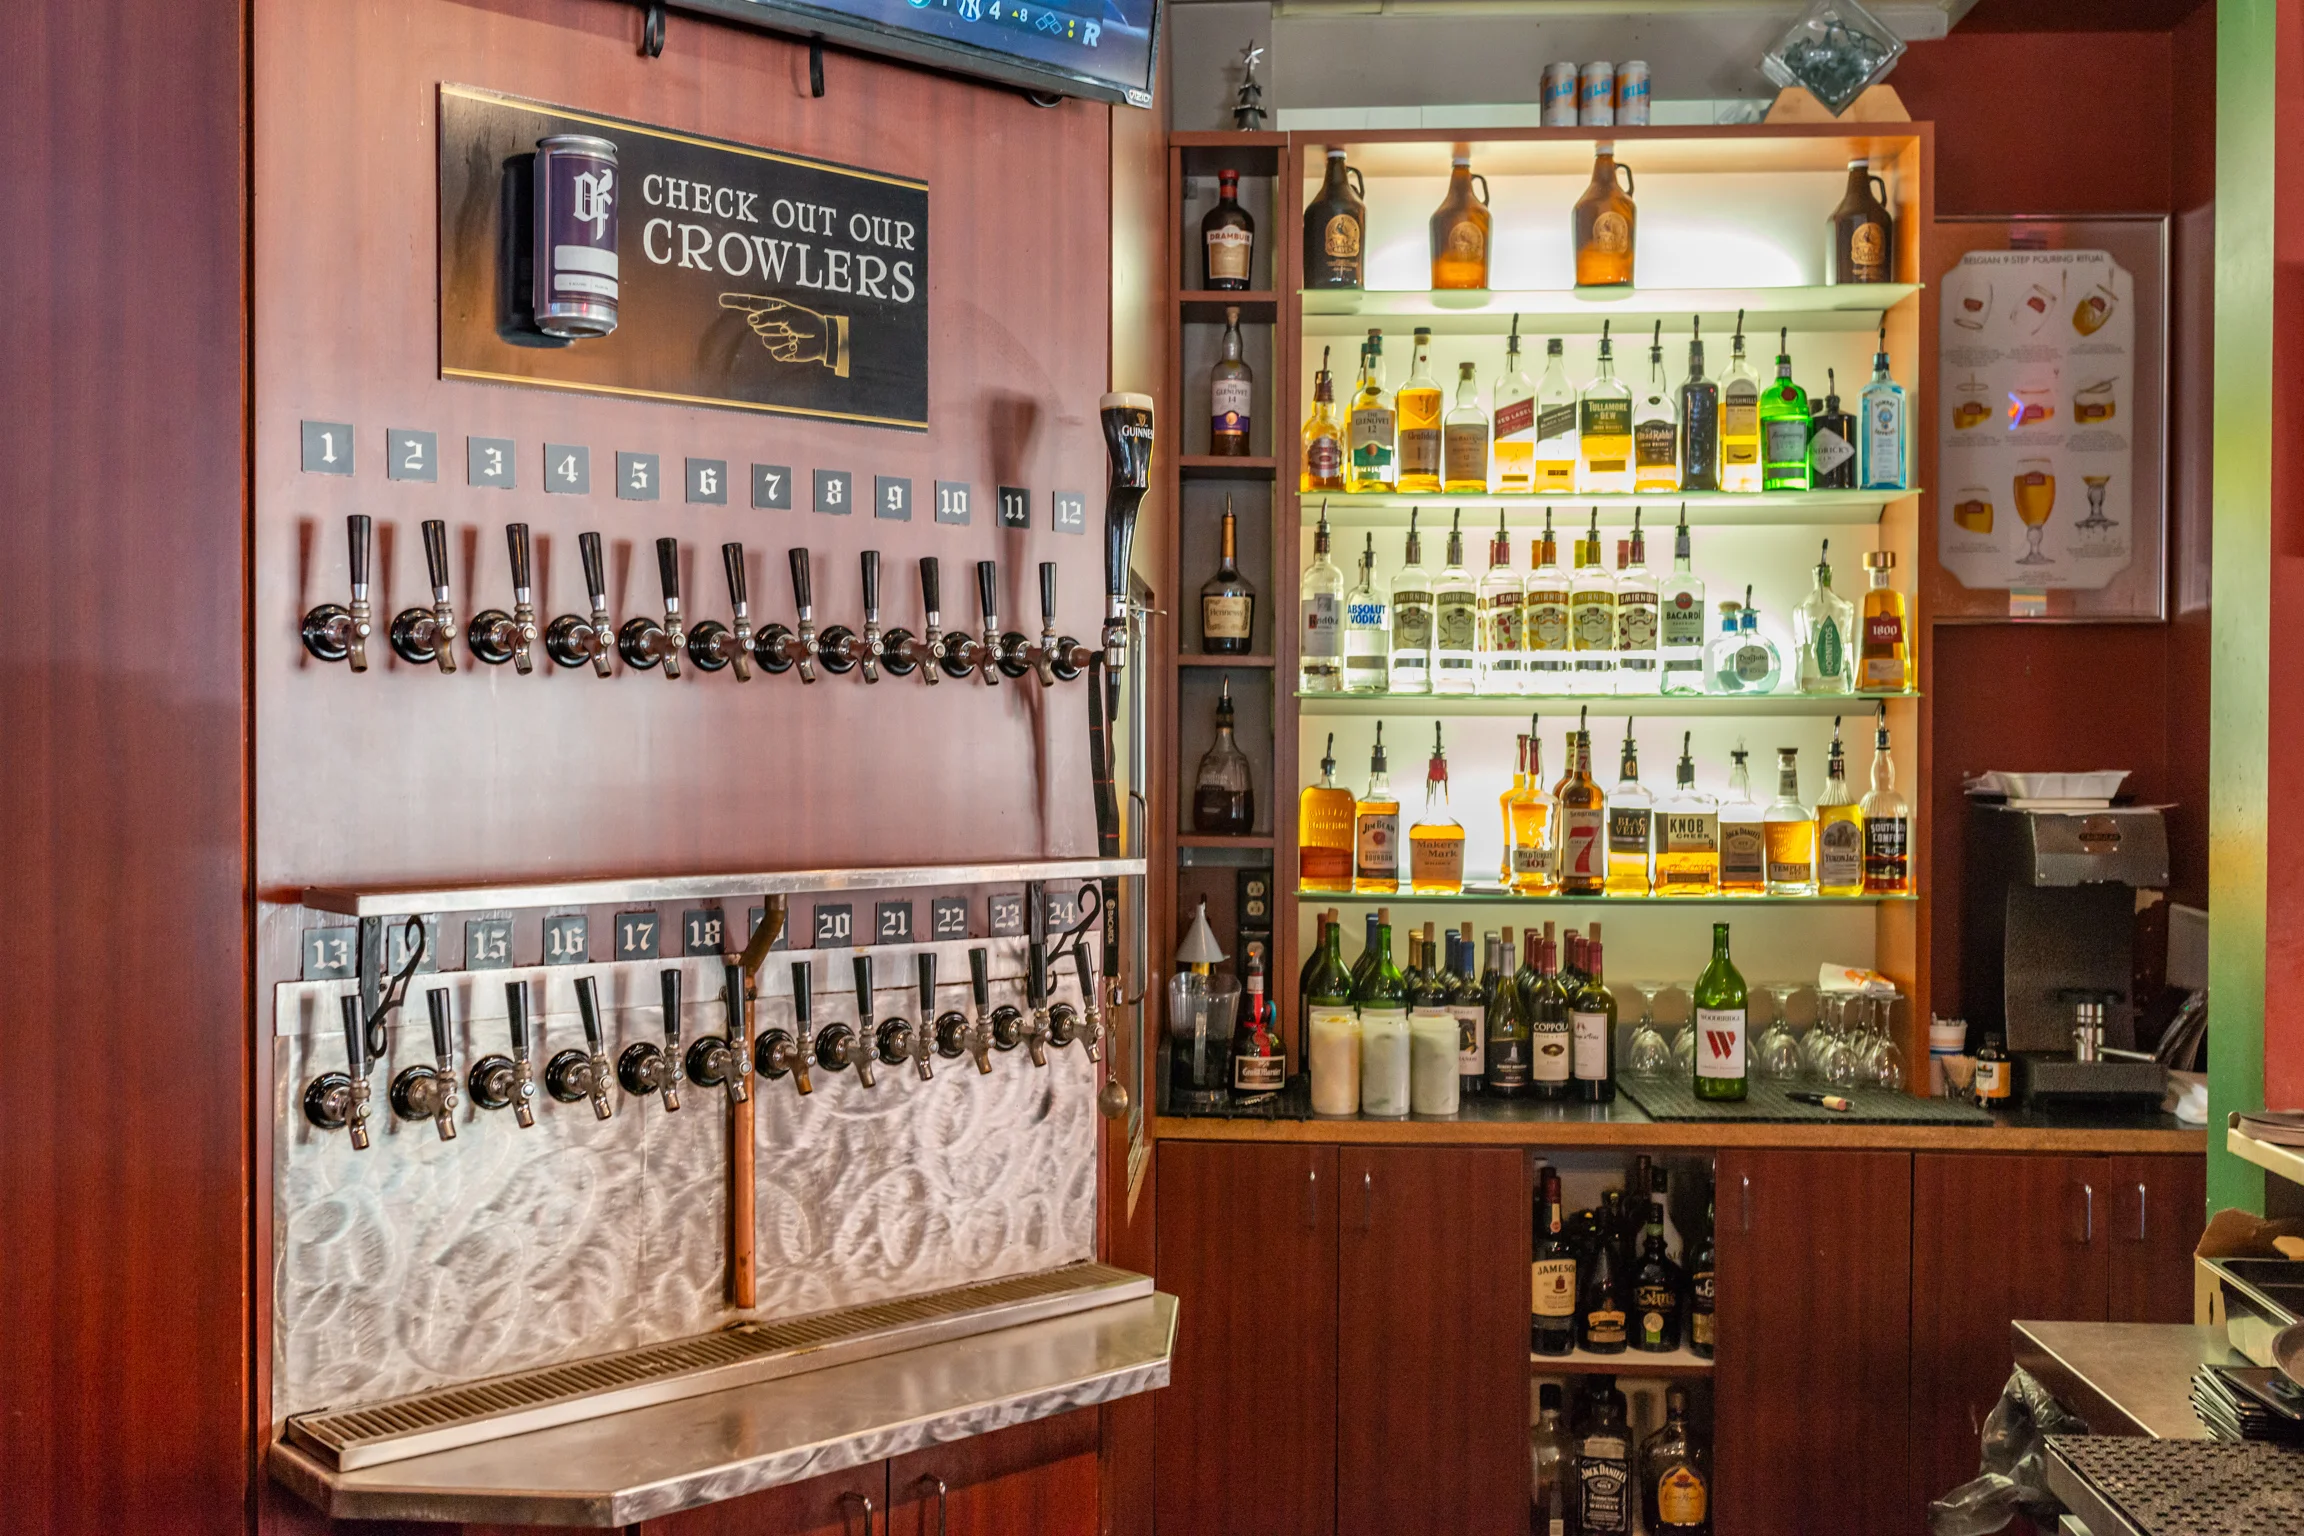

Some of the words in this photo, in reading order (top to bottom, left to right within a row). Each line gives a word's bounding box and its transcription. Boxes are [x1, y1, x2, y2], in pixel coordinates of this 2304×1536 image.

[642, 174, 758, 222] CHECK
[772, 199, 837, 236] OUT
[850, 214, 915, 251] OUR
[642, 218, 915, 303] CROWLERS
[1964, 256, 2001, 265] BELGIAN
[2011, 256, 2031, 264] STEP
[2033, 256, 2074, 264] POURING
[1588, 402, 1628, 412] TULLAMORE
[1356, 417, 1390, 426] GLENLIVET
[1368, 425, 1378, 433] 12
[321, 432, 338, 464] 1
[404, 440, 423, 471] 2
[484, 447, 502, 477] 3
[558, 454, 578, 483] 4
[630, 461, 648, 490] 5
[700, 468, 717, 496] 6
[764, 473, 781, 500] 7
[826, 478, 842, 505] 8
[887, 485, 903, 511] 9
[941, 489, 967, 515] 10
[1004, 494, 1025, 519] 11
[1059, 500, 1081, 524] 12
[1347, 604, 1386, 615] ABSOLUT
[1620, 593, 1657, 603] SMIRNOFF
[1350, 614, 1382, 625] VODKA
[1873, 625, 1898, 636] 1800
[1580, 755, 1588, 769] 7
[1363, 822, 1377, 834] JIM
[1377, 820, 1395, 834] BEAM
[1618, 818, 1647, 827] BLAC
[1670, 818, 1704, 833] KNOB
[1417, 841, 1459, 849] Maker's
[1518, 851, 1533, 859] WILD
[1568, 826, 1600, 873] 7
[1526, 860, 1545, 868] 101
[818, 911, 851, 940] 20
[882, 910, 909, 937] 21
[938, 907, 965, 933] 22
[994, 903, 1020, 928] 23
[1048, 901, 1076, 925] 24
[473, 929, 506, 960] 15
[550, 926, 585, 957] 16
[624, 923, 654, 953] 17
[690, 919, 721, 948] 18
[312, 938, 348, 969] 13
[1581, 1466, 1599, 1480] JACK
[1600, 1463, 1627, 1483] DANIEL'S
